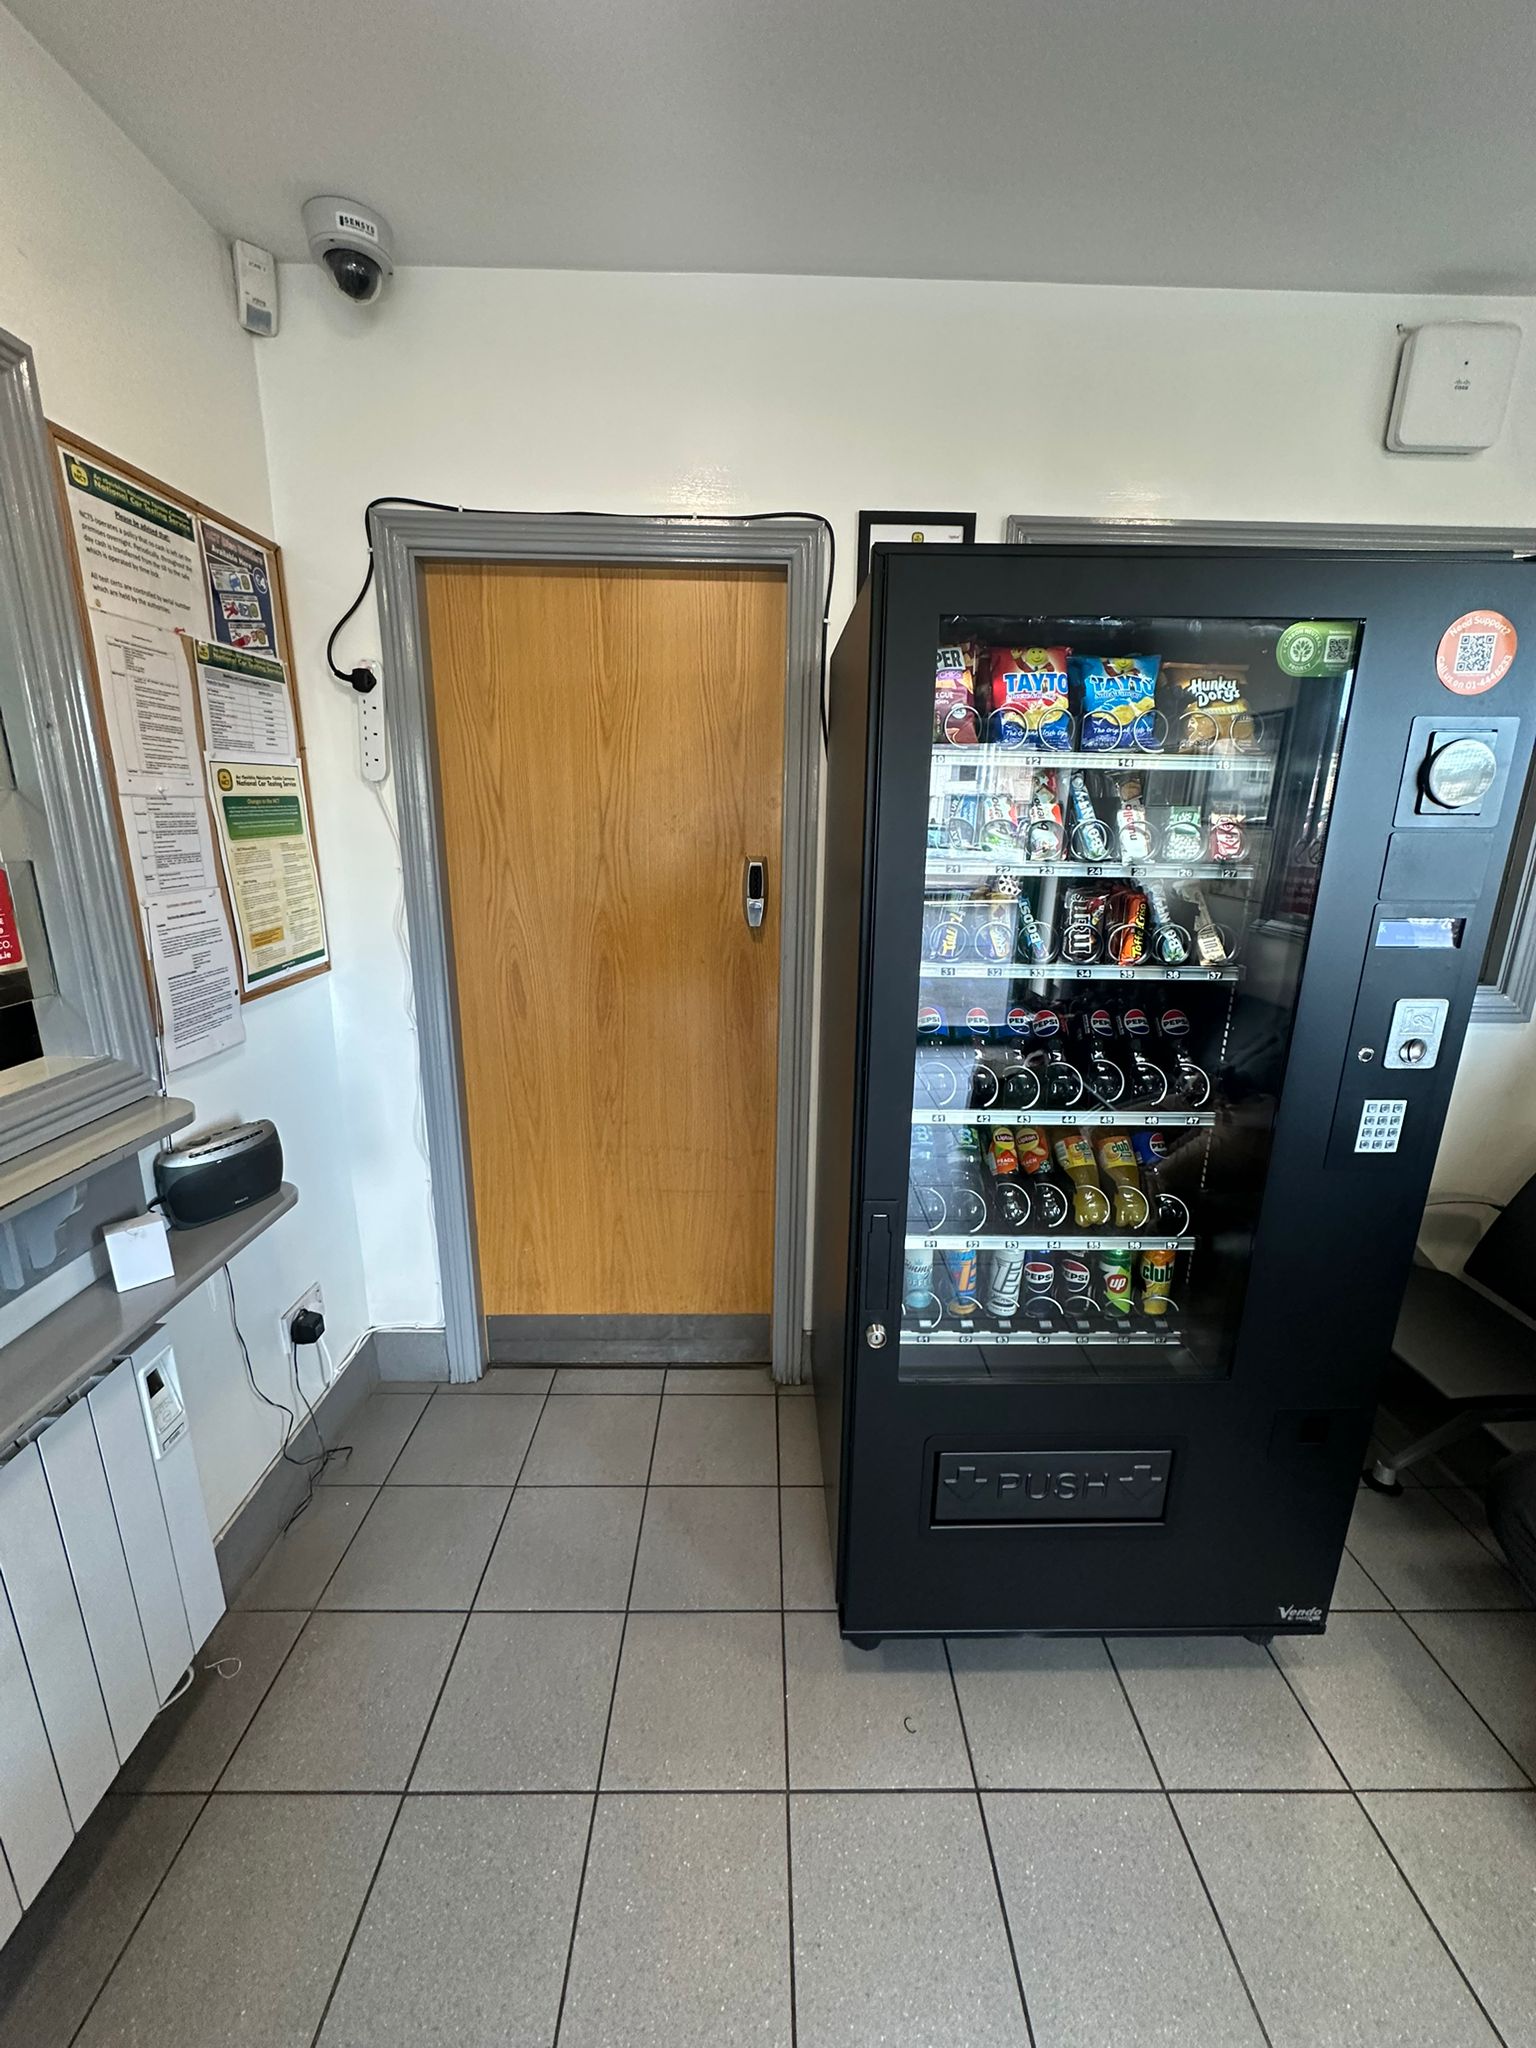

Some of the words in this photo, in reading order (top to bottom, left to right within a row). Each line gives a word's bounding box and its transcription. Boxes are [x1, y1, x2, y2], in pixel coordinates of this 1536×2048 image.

[114, 510, 131, 525] Please
[140, 522, 157, 535] advised
[94, 516, 118, 533] operates
[123, 529, 138, 542] policy
[155, 542, 165, 552] cash
[81, 522, 105, 538] premises
[160, 555, 185, 569] throughout
[83, 534, 94, 544] day
[94, 538, 106, 549] cash
[112, 545, 140, 560] transferred
[141, 556, 152, 565] from
[85, 545, 102, 558] which
[108, 554, 132, 569] operated
[139, 565, 149, 574] time
[98, 574, 109, 584] test
[132, 585, 155, 598] controlled
[92, 583, 108, 595] which
[118, 590, 130, 600] held
[1449, 617, 1473, 637] Need
[1474, 616, 1511, 636] Support?
[1283, 629, 1304, 648] CARBON
[1288, 663, 1311, 671] PROJECT
[1004, 673, 1068, 693] TAYTO
[1188, 676, 1237, 693] Hunky
[1119, 759, 1134, 767] 14
[267, 780, 282, 788] Testing
[1075, 790, 1103, 849] BONTY
[1124, 803, 1138, 841] nutella
[946, 865, 961, 873] 21
[1040, 866, 1055, 874] 23
[1087, 868, 1102, 876] 24
[1131, 868, 1146, 876] 25
[1178, 869, 1192, 877] 26
[1222, 869, 1237, 878] 27
[1018, 897, 1040, 944] BOOST
[1153, 886, 1182, 951] BONTY
[987, 968, 1002, 976] 32
[1076, 970, 1091, 978] 34
[1120, 970, 1134, 978] 35
[1166, 971, 1180, 979] 36
[1207, 971, 1223, 979] 37
[1034, 1019, 1058, 1029] PEPSI
[1017, 1115, 1031, 1123] 43
[1100, 1116, 1114, 1124] 45
[1185, 1117, 1200, 1125] 47
[1112, 1140, 1129, 1153] club
[1087, 1241, 1101, 1249] 55
[1128, 1241, 1142, 1249] 56
[1068, 1270, 1088, 1282] EPSI
[1142, 1261, 1173, 1282] club
[1037, 1336, 1050, 1344] 64
[1076, 1336, 1089, 1344] 65
[1117, 1336, 1130, 1344] 66
[996, 1471, 1108, 1502] PUSH
[1278, 1604, 1322, 1619] Vendo
